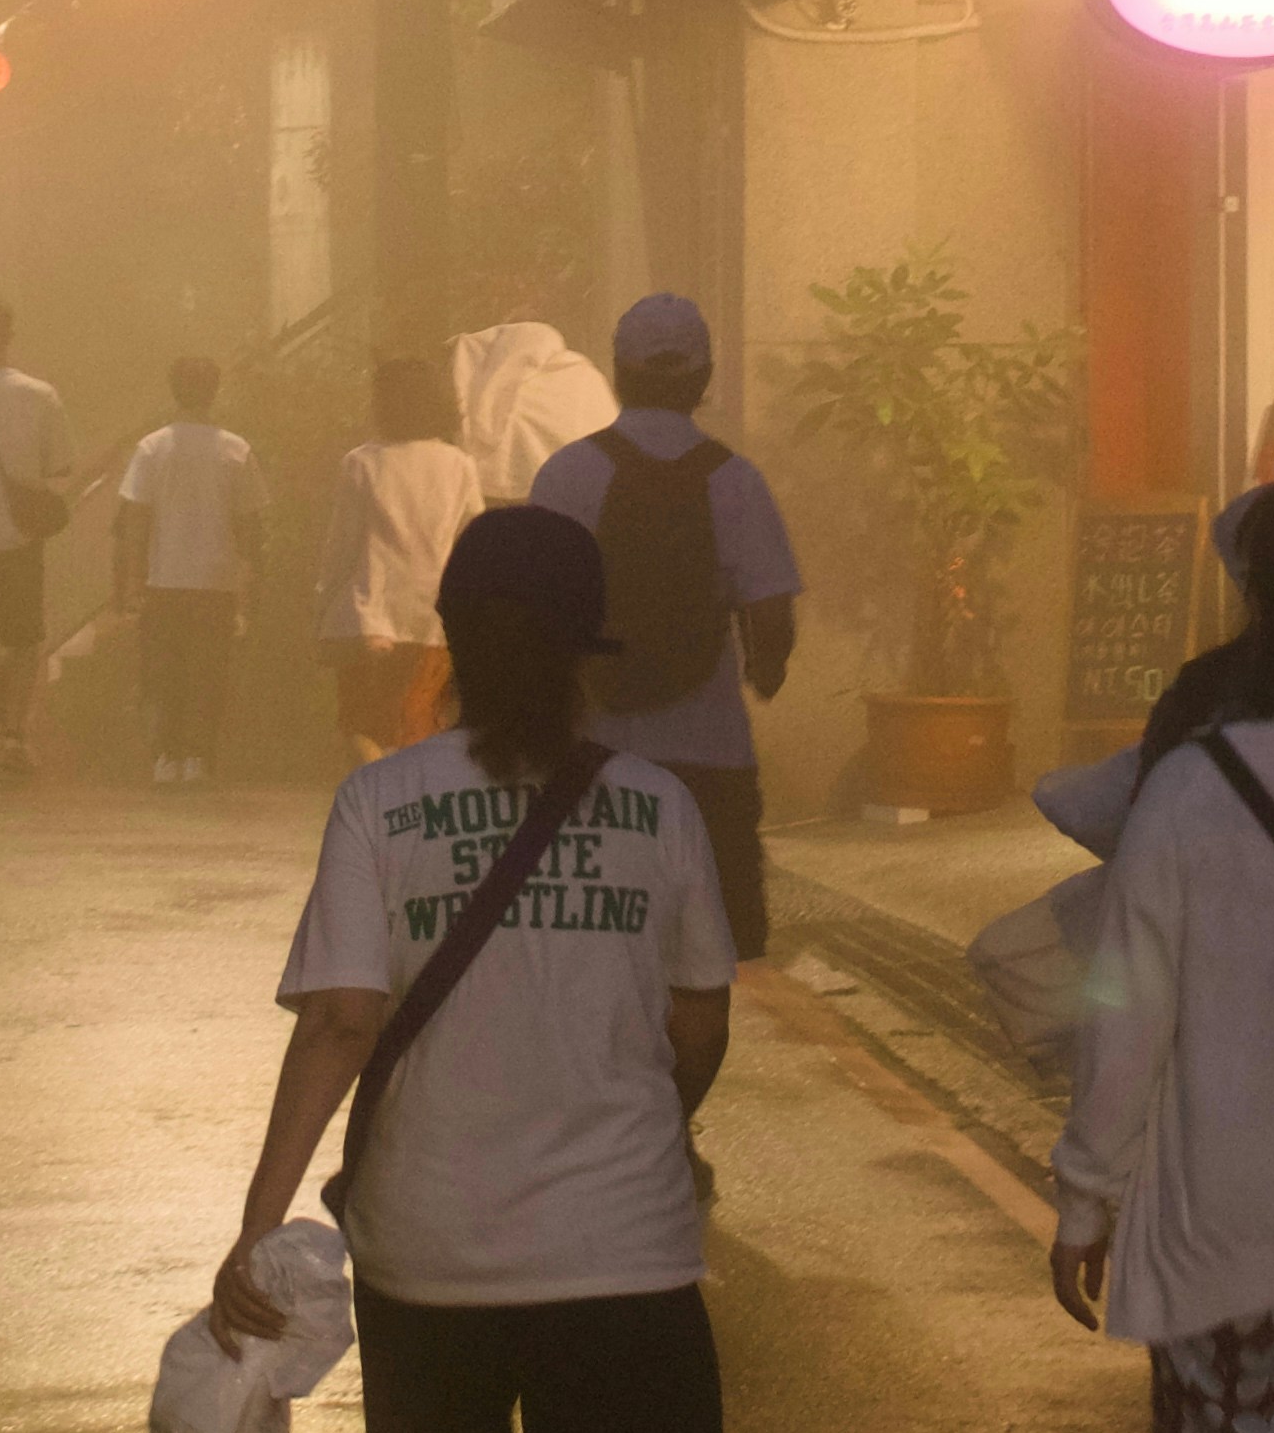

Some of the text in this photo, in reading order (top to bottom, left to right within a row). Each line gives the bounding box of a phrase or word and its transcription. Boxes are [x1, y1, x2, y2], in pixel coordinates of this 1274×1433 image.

[384, 786, 659, 839] THE MOUAIN
[451, 833, 602, 885] STTE
